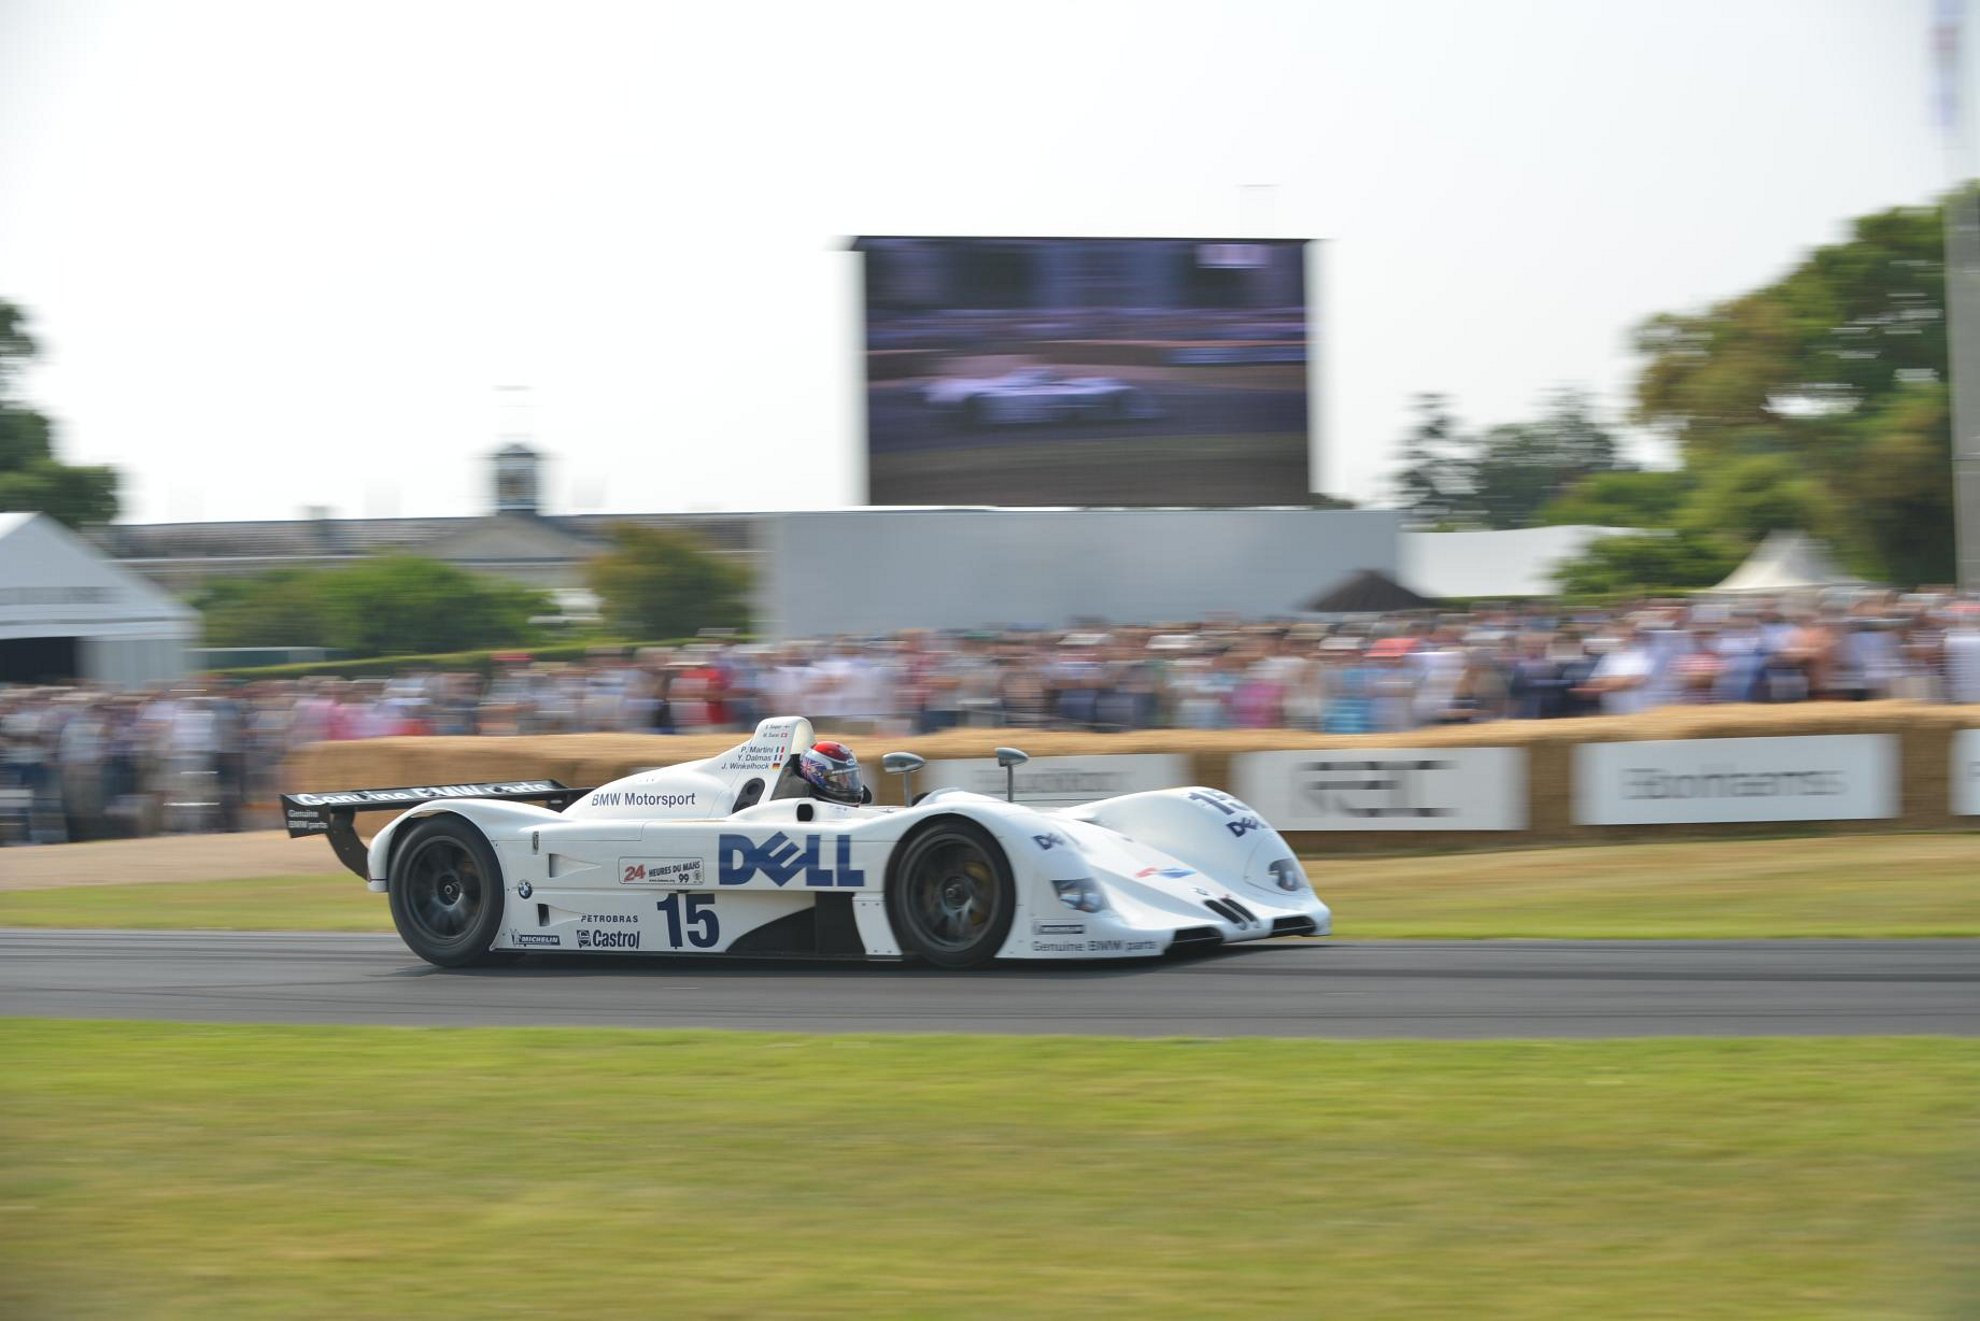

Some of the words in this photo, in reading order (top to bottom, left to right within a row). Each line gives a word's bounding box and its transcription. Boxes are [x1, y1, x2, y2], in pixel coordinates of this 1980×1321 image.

[591, 793, 621, 806] BMW
[624, 792, 696, 808] Motorsport
[719, 831, 865, 887] DELL
[624, 864, 646, 882] 24
[648, 865, 672, 877] HEURES
[672, 864, 682, 873] DU
[678, 873, 690, 883] 99
[580, 915, 639, 923] PETROBRAS
[656, 893, 720, 949] 15
[520, 935, 559, 944] MICHELIN
[592, 929, 640, 949] Castrol
